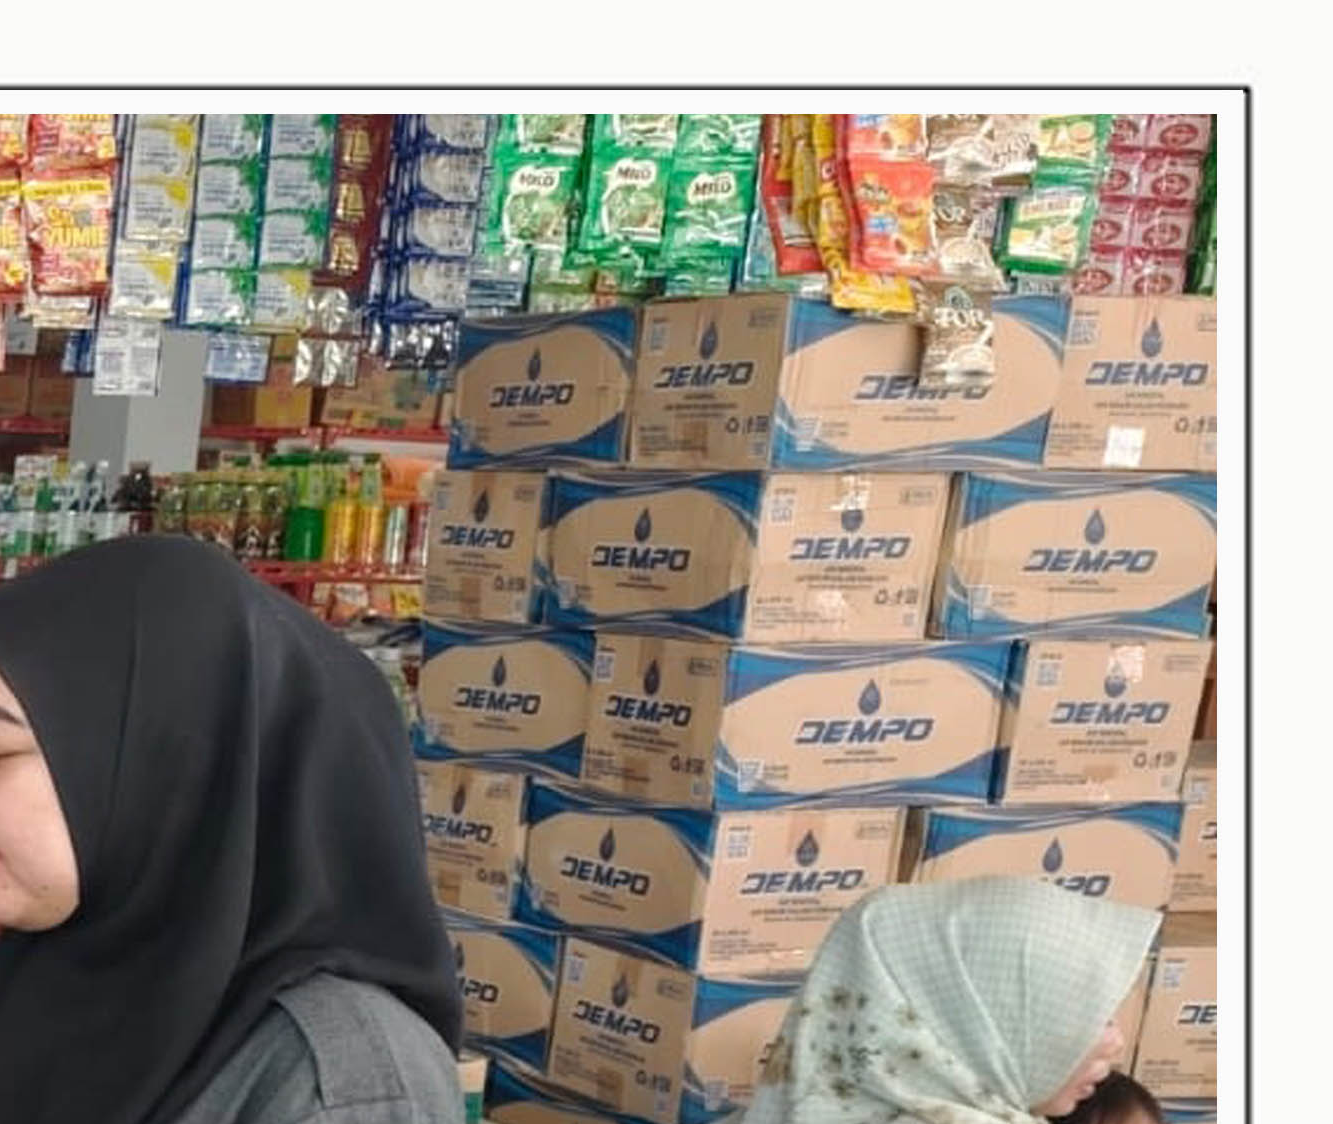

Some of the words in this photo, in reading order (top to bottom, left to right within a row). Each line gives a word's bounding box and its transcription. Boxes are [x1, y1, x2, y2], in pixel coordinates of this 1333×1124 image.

[46, 226, 104, 247] YUMIE
[654, 361, 754, 389] DEMPO
[1086, 361, 1208, 388] DEMPO
[490, 383, 575, 408] DEMPO
[440, 525, 514, 549] DEMPO
[789, 536, 911, 561] DEMPO
[591, 545, 691, 571] DEMPO
[1024, 548, 1159, 574] DEMPO
[453, 687, 541, 715] DEMPO
[605, 694, 692, 727] DEMPO
[1050, 701, 1171, 725] DEMPO
[794, 717, 935, 745] DEMPO
[421, 814, 494, 844] DEMPO
[560, 856, 650, 897] DEMPO
[740, 869, 865, 895] DEMPO
[572, 1000, 660, 1045] DEMPO
